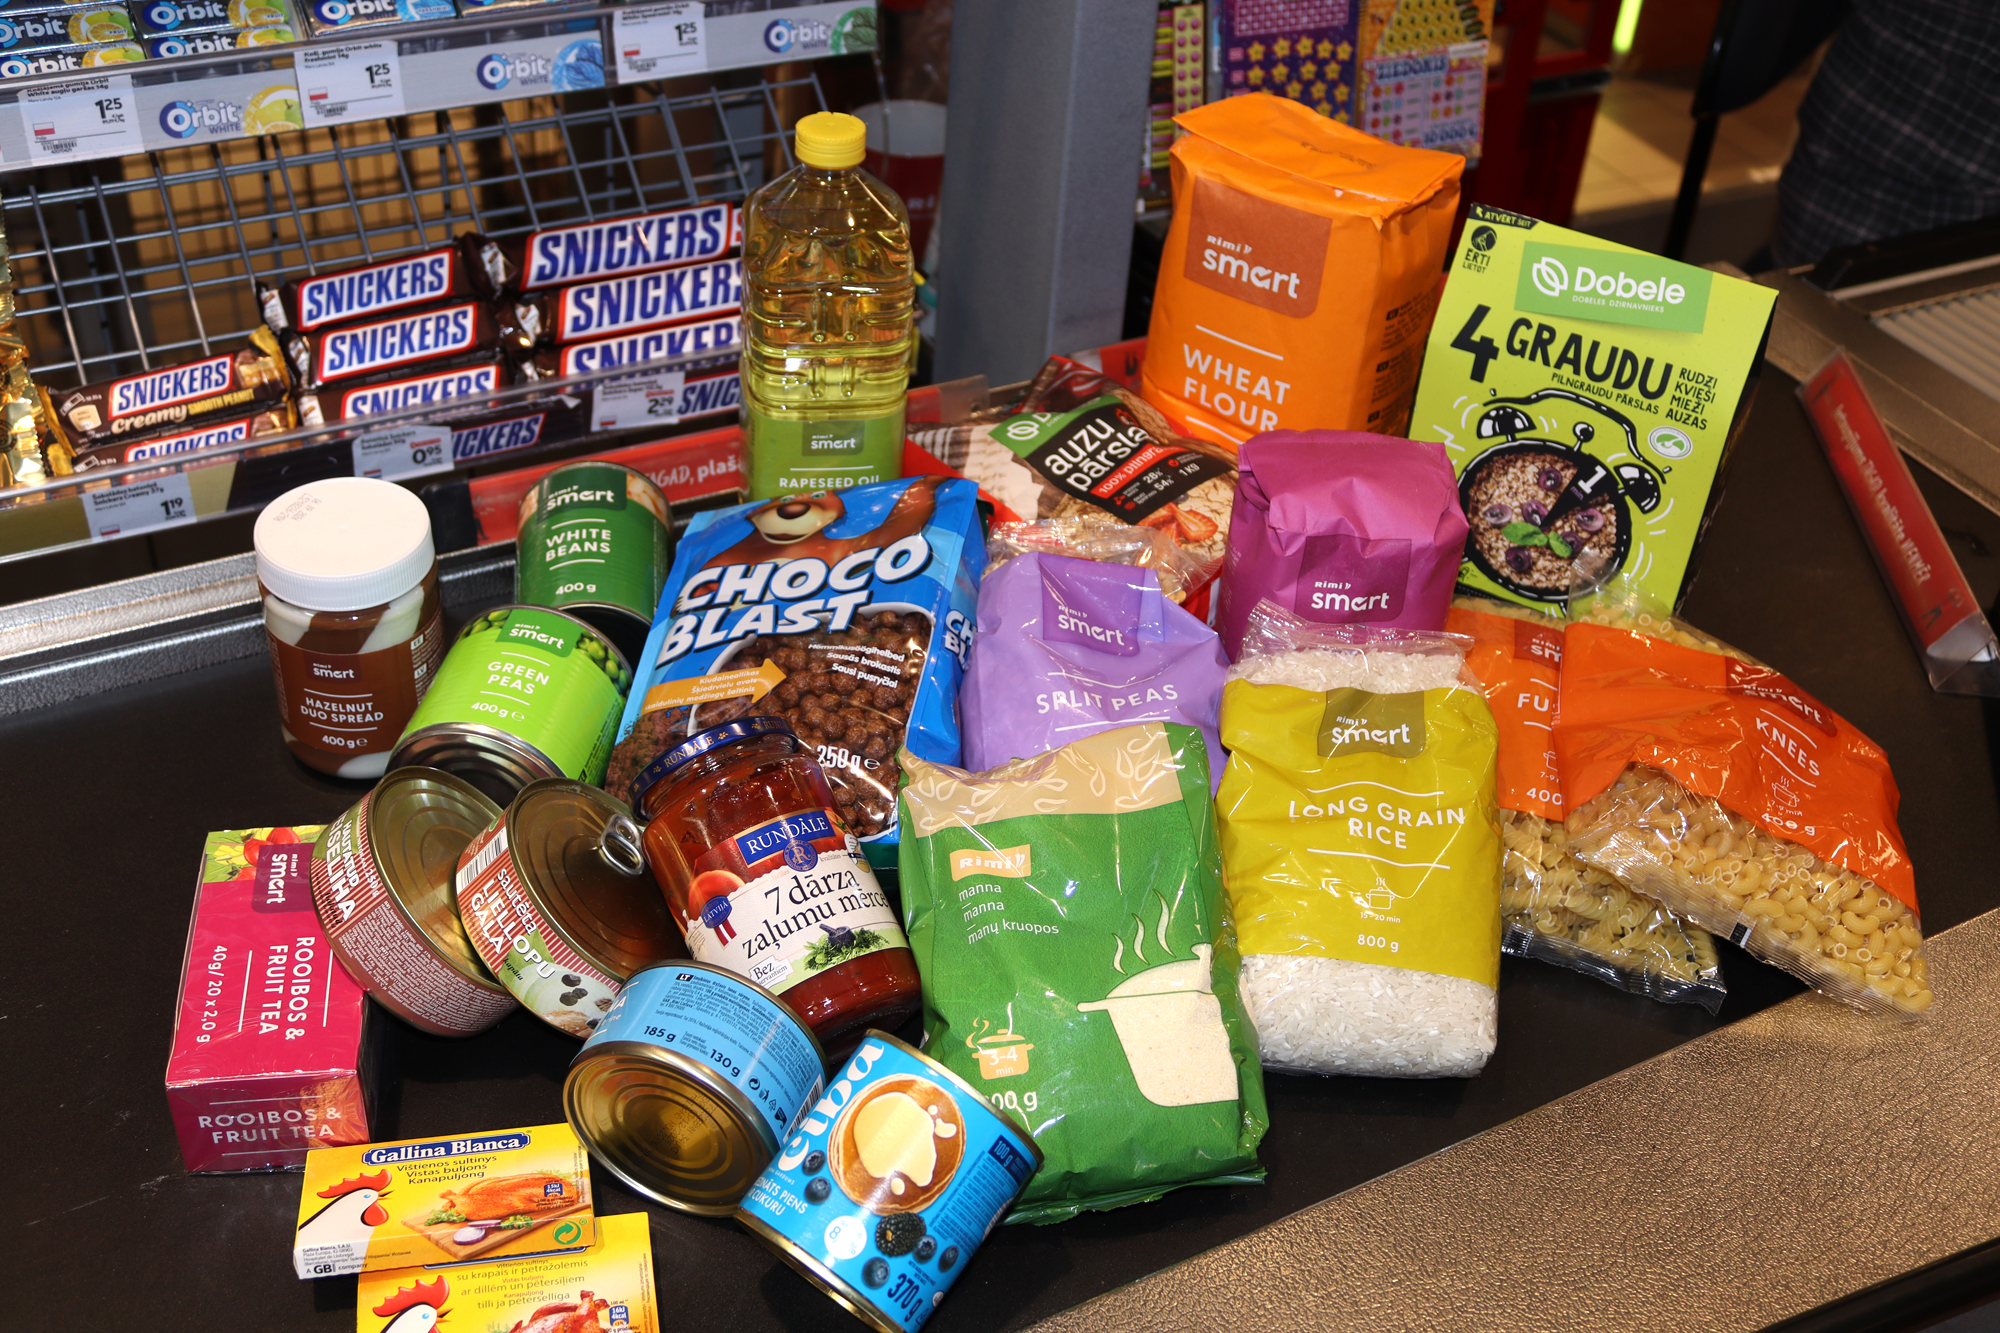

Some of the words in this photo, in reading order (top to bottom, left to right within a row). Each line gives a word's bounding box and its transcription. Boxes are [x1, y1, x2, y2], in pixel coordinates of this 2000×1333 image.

[151, 1, 226, 25] Orbit
[0, 17, 66, 43] Orbit
[159, 34, 235, 58] Orbit
[1, 54, 80, 78] Orbit
[481, 54, 549, 86] Orbit
[164, 100, 238, 134] Orbit
[208, 122, 242, 134] WHITE
[1484, 211, 1517, 226] ATVĒRT
[534, 208, 723, 283] SNICKERS
[1202, 248, 1300, 298] smart
[1462, 262, 1487, 275] LIETOT
[306, 257, 445, 322] SNICKERS
[1574, 266, 1686, 305] Dobele
[1572, 295, 1607, 308] DOBELES
[329, 309, 468, 371] SNICKERS
[1450, 304, 1500, 384] 4
[1506, 317, 1674, 400] GRAUDU
[1183, 343, 1291, 405] WHEAT
[118, 361, 228, 412] SNICKERS
[1551, 372, 1615, 402] PILNGRAUDU
[1614, 391, 1660, 416] PĀRSLAS
[111, 405, 187, 434] creamy
[188, 396, 225, 416] SMOOTH
[224, 388, 255, 406] PEANUT
[1184, 377, 1279, 431] FLOUR
[1665, 408, 1708, 431] AUZAS
[451, 417, 540, 459] ICKERS
[1044, 417, 1116, 476] auzu
[649, 465, 695, 488] AGAD,
[778, 476, 855, 489] RAPESEED
[1098, 472, 1127, 494] 100%
[1577, 465, 1607, 494] 1
[545, 528, 612, 549] WHITE
[545, 541, 612, 563] BEANS
[676, 536, 930, 613] CHOCO
[555, 582, 585, 595] 400
[1311, 592, 1390, 612] smart
[656, 591, 869, 666] BLAST
[313, 667, 355, 679] smart
[487, 661, 550, 686] GREEN
[699, 670, 760, 685] Kiudaineallikas
[831, 662, 858, 677] Sausi
[857, 671, 898, 689] pusryčiai
[860, 656, 901, 676] brokastis
[487, 674, 536, 695] PEAS
[736, 678, 758, 686] avots
[305, 697, 373, 713] HAZELNUT
[686, 692, 726, 704] medžiagų
[727, 686, 755, 695] šaltinis
[1036, 689, 1103, 715] SPLIT
[1111, 684, 1178, 711] PEAS
[1744, 690, 1822, 724] smart
[301, 705, 328, 721] DUO
[331, 711, 384, 724] SPREAD
[470, 702, 498, 714] 400
[322, 735, 345, 746] 400
[1331, 722, 1411, 746] smart
[817, 745, 849, 768] 250
[1755, 717, 1821, 777] KNEES
[1526, 787, 1563, 806] 400
[1288, 796, 1370, 819] LONG
[1377, 802, 1466, 828] GRAIN
[1761, 812, 1799, 830] 400
[1348, 817, 1408, 850] RICE
[341, 820, 360, 888] HAUTATUD
[497, 868, 537, 936] sautēta
[764, 886, 781, 916] 7
[788, 869, 860, 907] dārza
[959, 883, 1002, 902] manna
[471, 892, 505, 955] GAĻA
[963, 900, 1005, 923] manna
[482, 879, 556, 980] LIELLOPU
[742, 902, 837, 960] zaļumu
[840, 888, 890, 914] mērce
[967, 922, 999, 945] manų
[1002, 918, 1060, 936] kruopos
[1356, 934, 1387, 949] 800
[262, 944, 290, 994] FRUIT
[288, 935, 316, 1024] ROOIBOS
[753, 961, 776, 981] Bez
[207, 980, 221, 996] 20
[201, 1008, 219, 1032] 2,0
[258, 996, 281, 1035] TEA
[643, 1025, 666, 1038] 185
[709, 1048, 732, 1068] 130
[988, 1046, 1019, 1065] 3-4
[995, 1064, 1015, 1076] min
[198, 1108, 319, 1129] ROOIBOS
[211, 1128, 278, 1144] FRUIT
[289, 1123, 335, 1138] TEA
[370, 1145, 447, 1164] Gallina
[450, 1136, 521, 1156] Blanca
[396, 1161, 450, 1173] Vištienos
[453, 1155, 498, 1166] sultinys
[406, 1170, 441, 1179] Vistas
[443, 1163, 488, 1175] buljons
[408, 1170, 486, 1186] Kanapuljong
[751, 1190, 786, 1217] CUKURU
[779, 1189, 809, 1215] PIENS
[313, 1264, 332, 1275] GB
[338, 1263, 368, 1272] company
[456, 1273, 470, 1282] su
[471, 1267, 509, 1282] krapais
[511, 1266, 519, 1275] ir
[520, 1259, 589, 1276] petražolėmis
[461, 1288, 471, 1297] ar
[473, 1283, 507, 1296] dillēm
[509, 1281, 525, 1291] un
[526, 1273, 586, 1291] pētersīļiem
[477, 1299, 495, 1310] tilli
[508, 1291, 571, 1309] peterselliga
